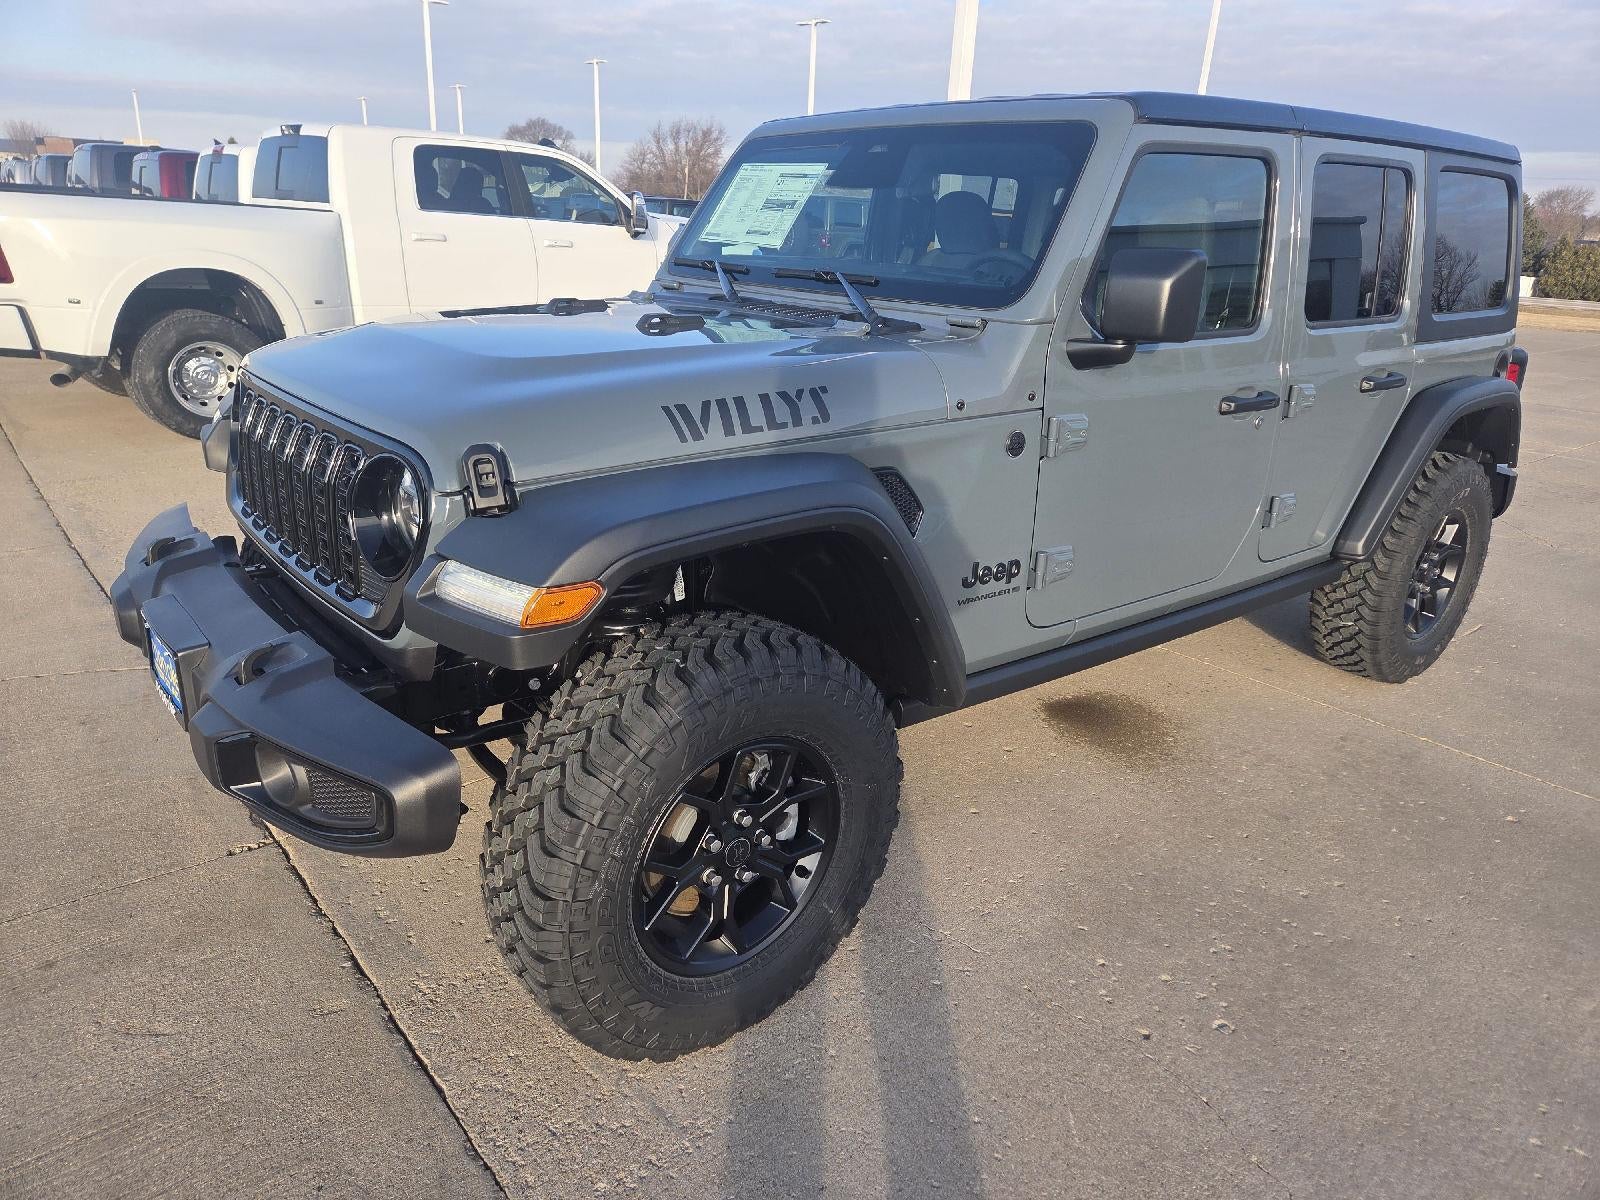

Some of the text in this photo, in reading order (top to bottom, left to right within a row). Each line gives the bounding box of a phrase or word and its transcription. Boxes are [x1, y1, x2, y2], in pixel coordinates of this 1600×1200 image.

[661, 386, 831, 443] WILLYS
[961, 559, 1022, 588] Jeep
[957, 588, 1010, 606] WRANGLER
